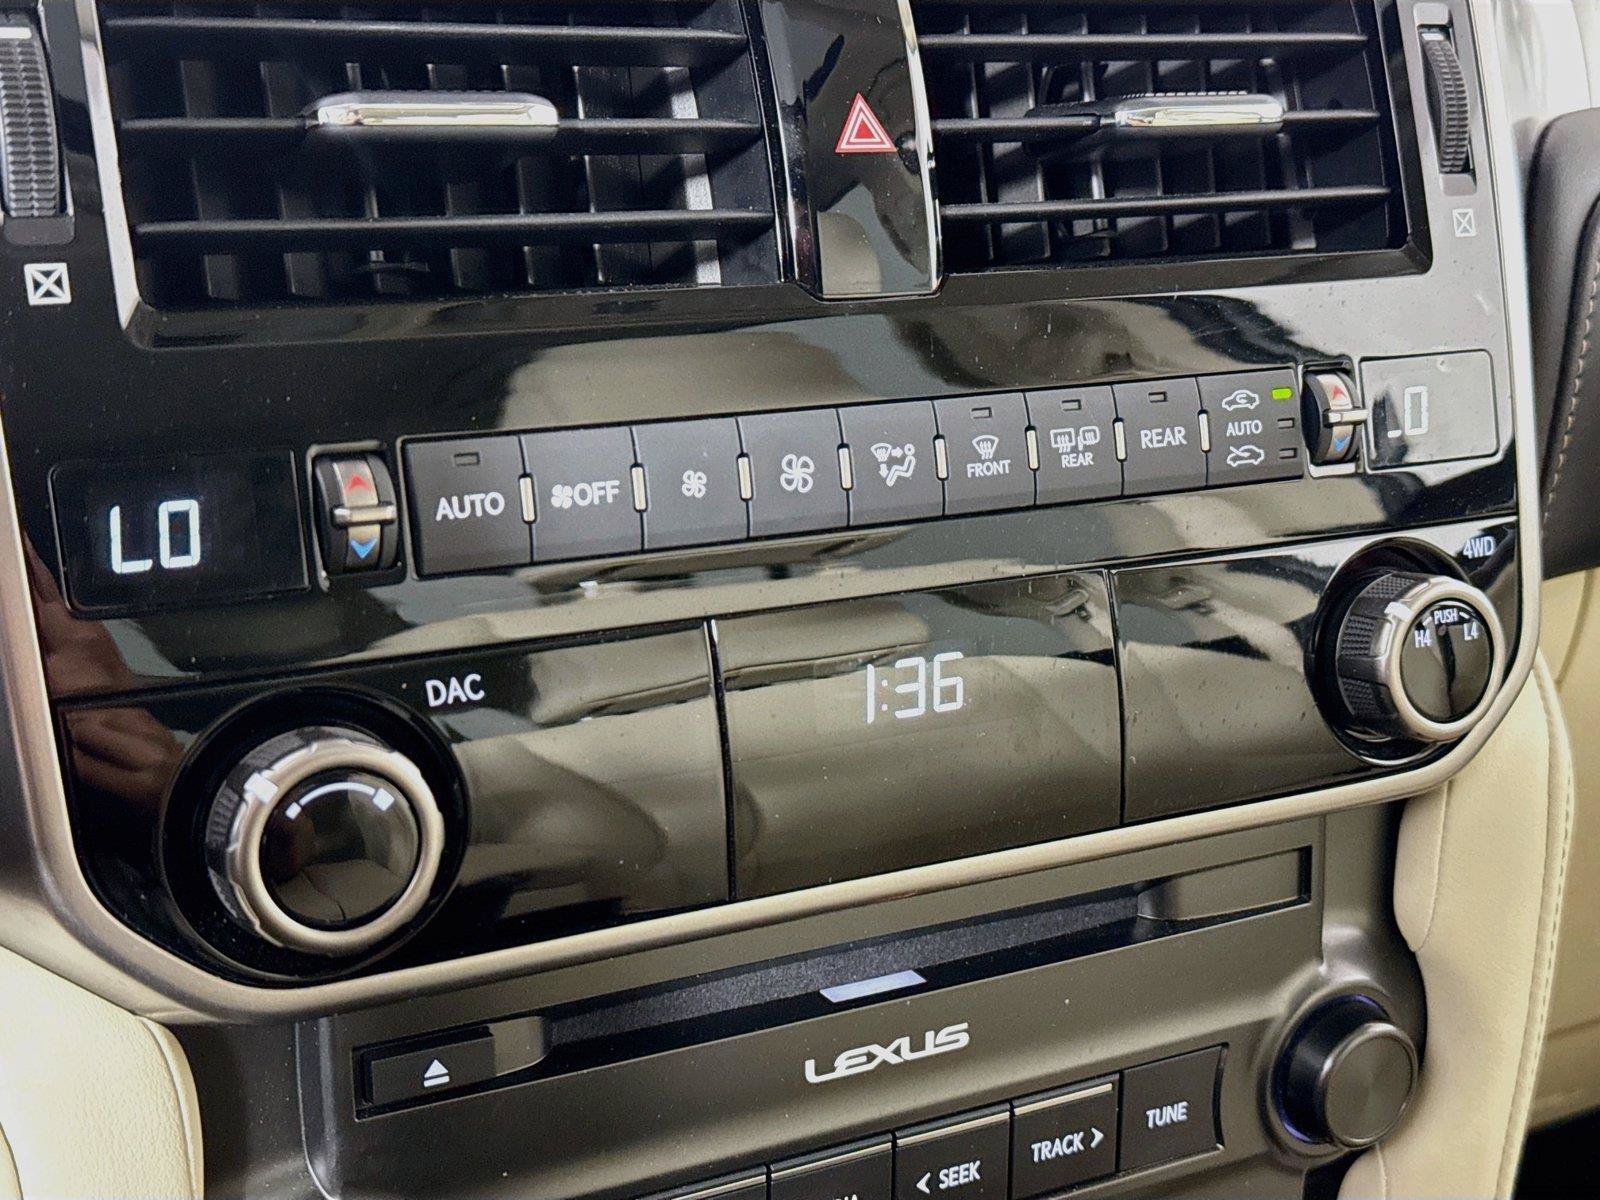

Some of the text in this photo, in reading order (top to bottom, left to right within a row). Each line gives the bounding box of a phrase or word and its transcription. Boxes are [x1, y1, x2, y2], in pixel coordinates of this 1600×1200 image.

[1140, 426, 1187, 449] REAR
[1226, 421, 1262, 437] AUTO
[967, 460, 1011, 478] FRONT
[1061, 452, 1094, 468] REAR
[435, 491, 505, 521] AUTO
[573, 480, 620, 506] OFF
[110, 499, 201, 574] LO
[1462, 536, 1496, 559] 4WD
[1434, 608, 1458, 625] PUSH
[1414, 628, 1431, 648] H4
[1463, 621, 1479, 641] L4
[425, 673, 485, 707] DAC
[867, 651, 964, 724] 1:36
[804, 1022, 970, 1084] LEXUS
[1146, 1101, 1189, 1129] TUNE
[1031, 1134, 1085, 1162] TRACK
[938, 1160, 981, 1190] SEEK
